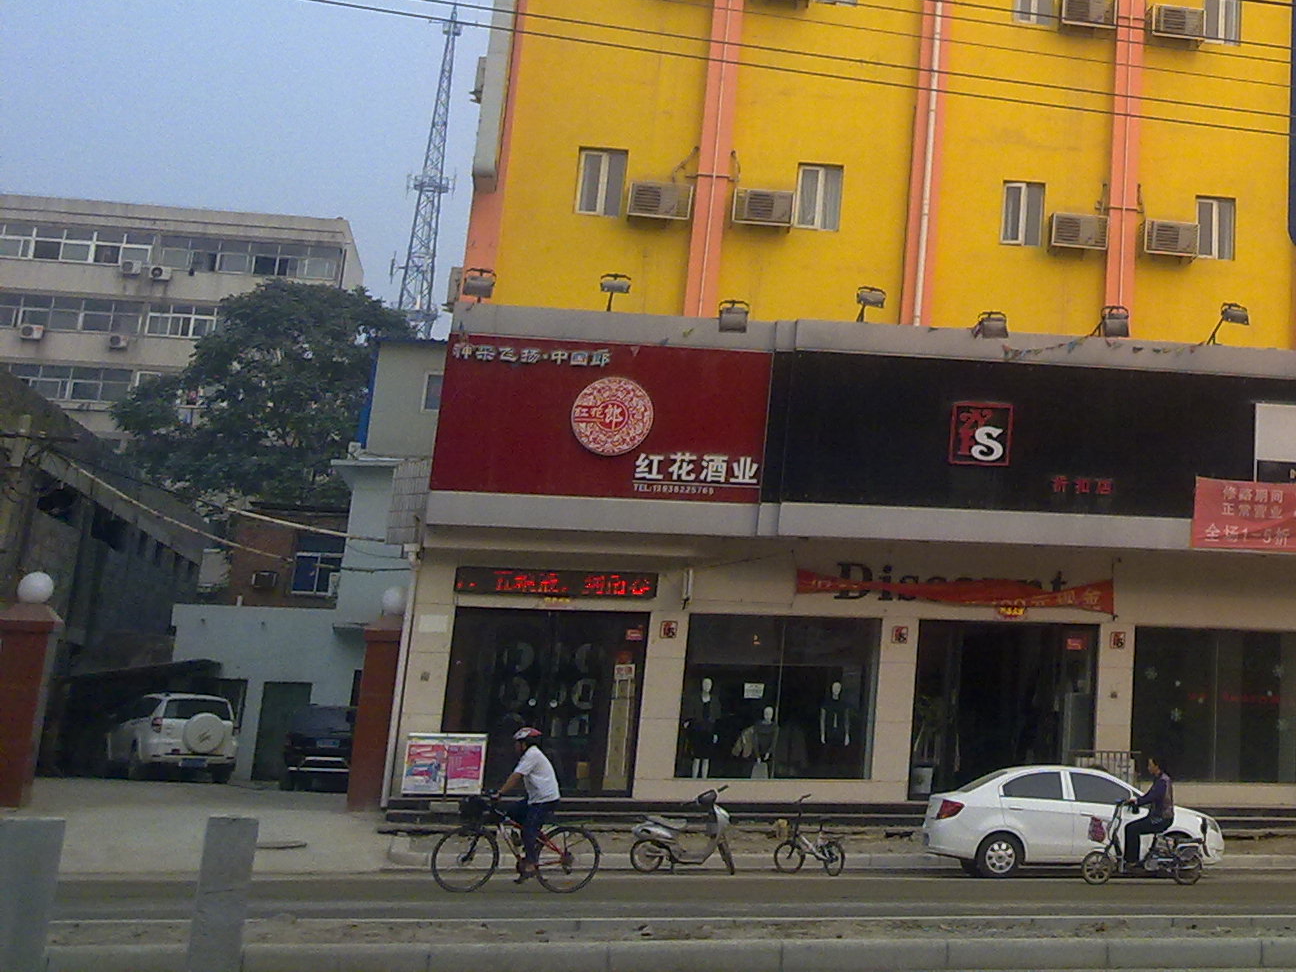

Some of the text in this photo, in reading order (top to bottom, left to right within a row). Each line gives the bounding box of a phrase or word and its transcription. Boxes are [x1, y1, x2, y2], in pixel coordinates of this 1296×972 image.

[633, 452, 759, 483] 红花酒业
[1051, 475, 1114, 495] 折扣店
[1221, 502, 1284, 519] 正常营业
